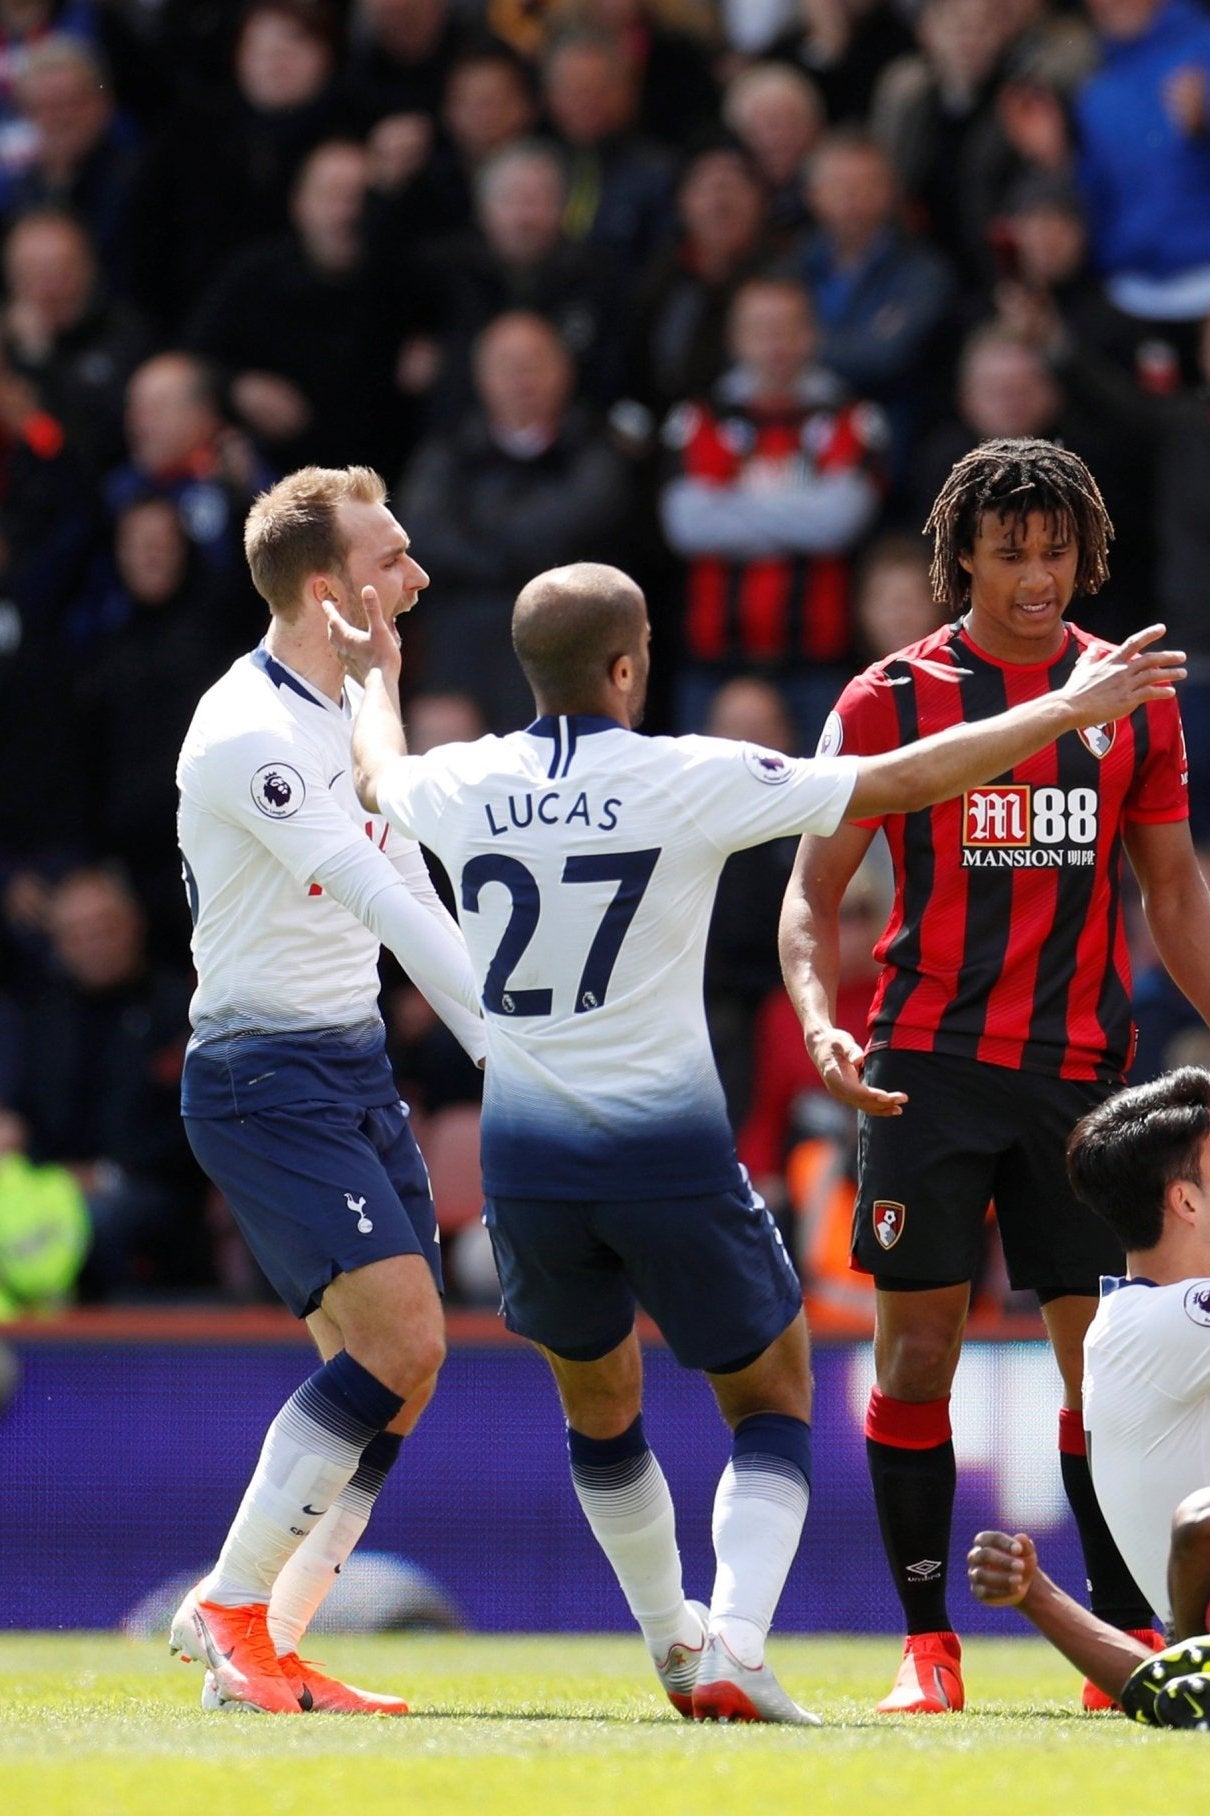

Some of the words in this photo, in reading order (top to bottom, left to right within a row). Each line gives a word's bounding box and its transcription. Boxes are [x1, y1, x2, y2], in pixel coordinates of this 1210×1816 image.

[485, 792, 623, 837] LUCAS
[961, 849, 1065, 867] MANSION
[461, 847, 663, 1017] 27
